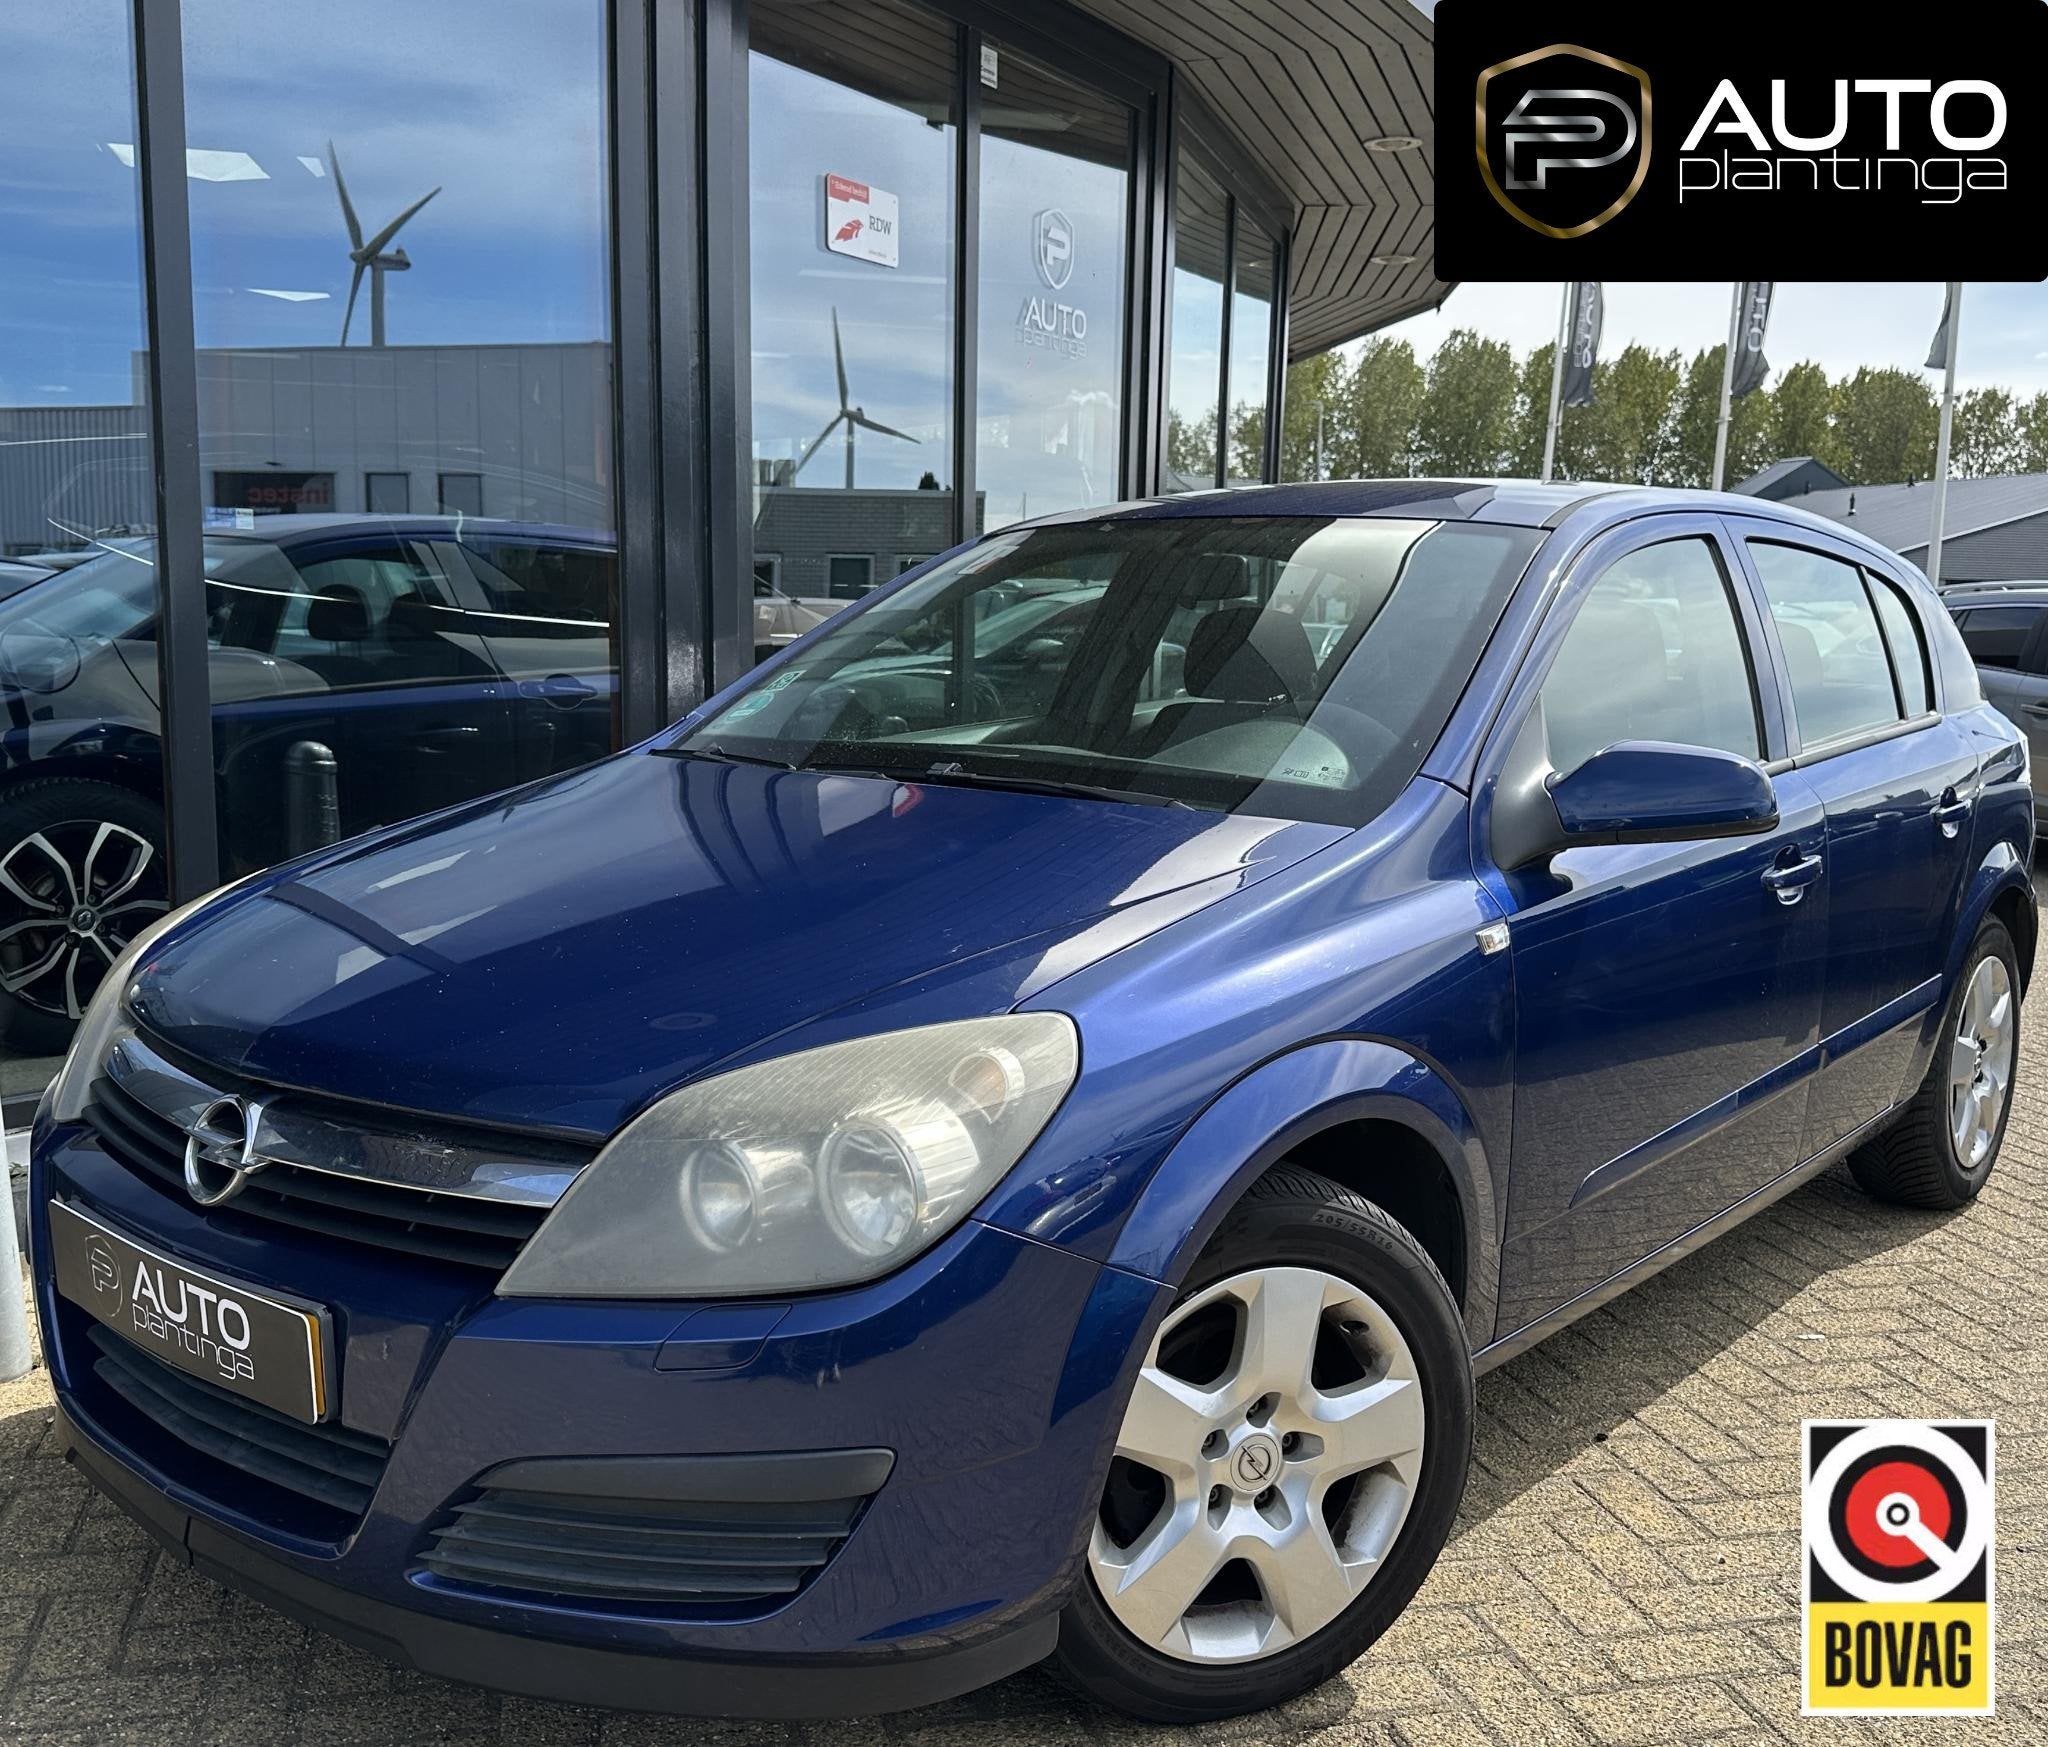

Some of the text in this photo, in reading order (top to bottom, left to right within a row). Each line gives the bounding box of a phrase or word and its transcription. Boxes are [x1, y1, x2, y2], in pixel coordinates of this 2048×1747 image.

[869, 214, 893, 236] RDW
[1024, 296, 1087, 340] AUTO
[1313, 1213, 1394, 1251] 205/55R16
[132, 1260, 251, 1351] AUTO
[132, 1302, 255, 1381] plantinga
